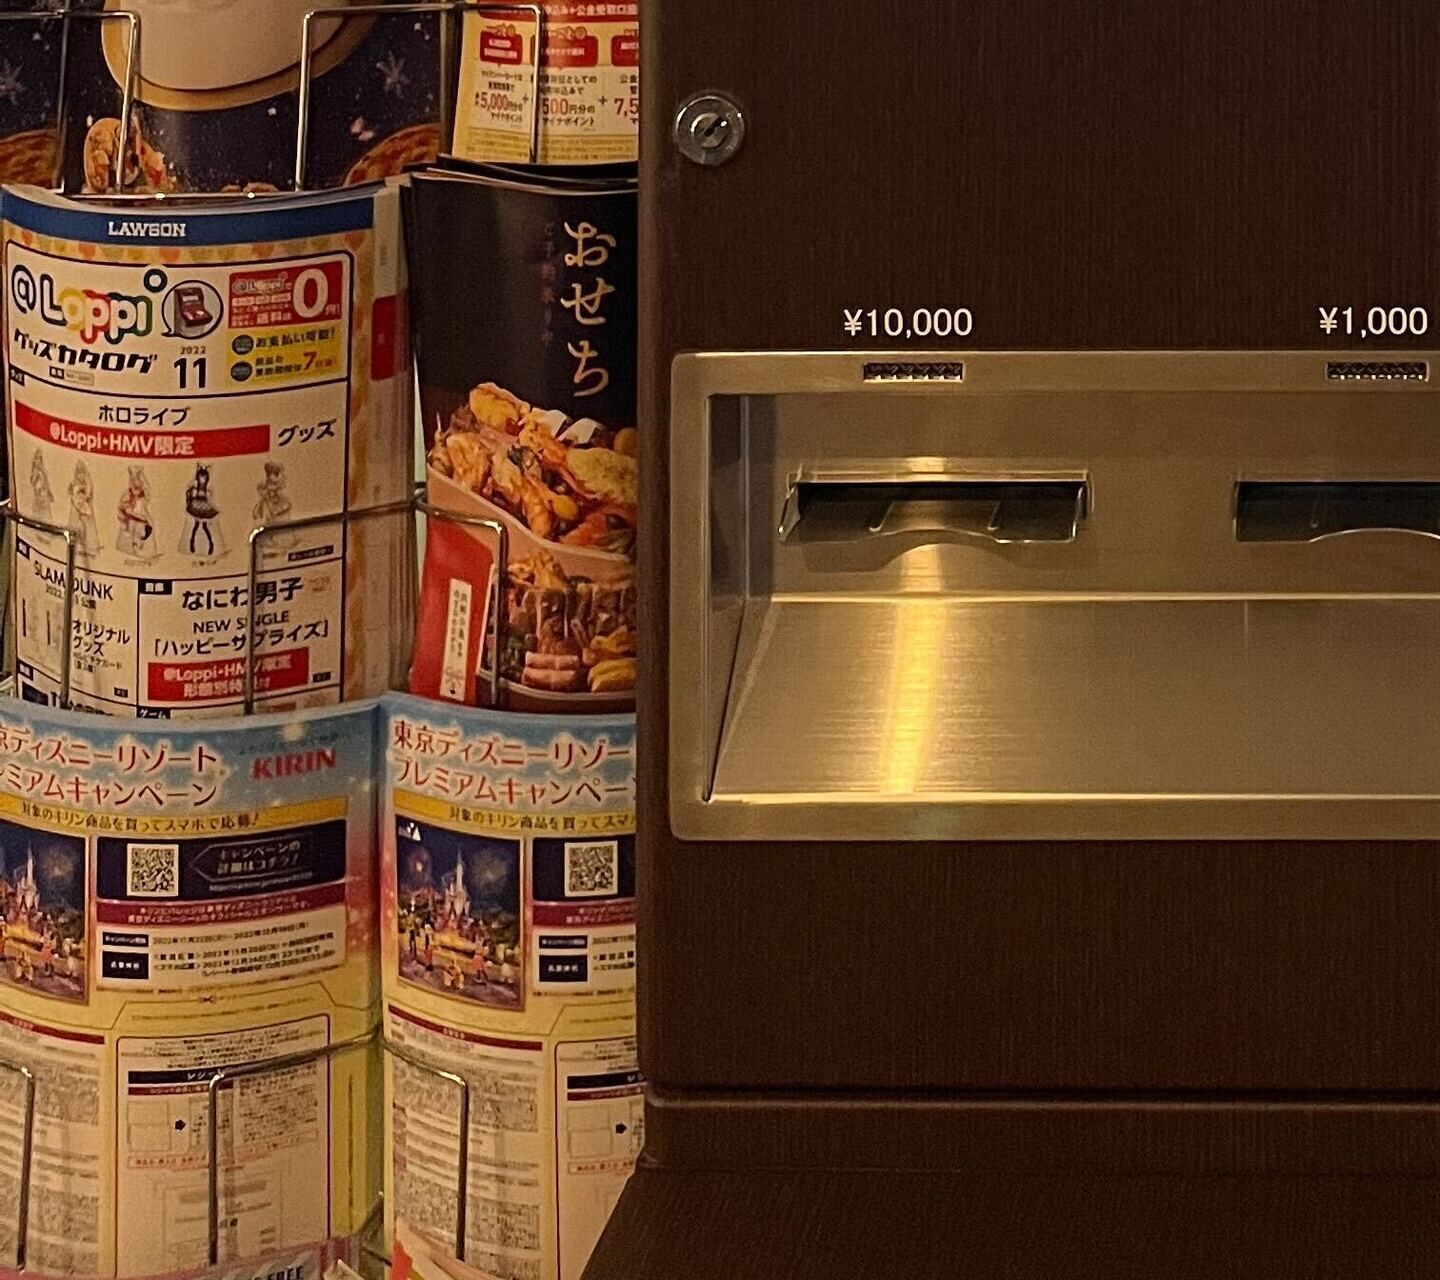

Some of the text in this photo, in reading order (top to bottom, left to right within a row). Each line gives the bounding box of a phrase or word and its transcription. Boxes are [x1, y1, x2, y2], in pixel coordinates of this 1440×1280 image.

[108, 221, 187, 238] LAWSON
[560, 220, 616, 397] おせち
[843, 308, 973, 339] ¥10,000
[1319, 307, 1428, 338] ¥1,000
[14, 328, 158, 374] グッズカタログ
[180, 346, 207, 355] 2022
[173, 357, 207, 389] 11
[99, 405, 191, 427] ホロライブ
[278, 418, 337, 447] グッズ
[193, 619, 231, 634] NEW
[252, 748, 337, 781] KIRIN
[0, 762, 217, 808] ミアムキャンペーン
[397, 758, 636, 806] プレミアムキャンペー
